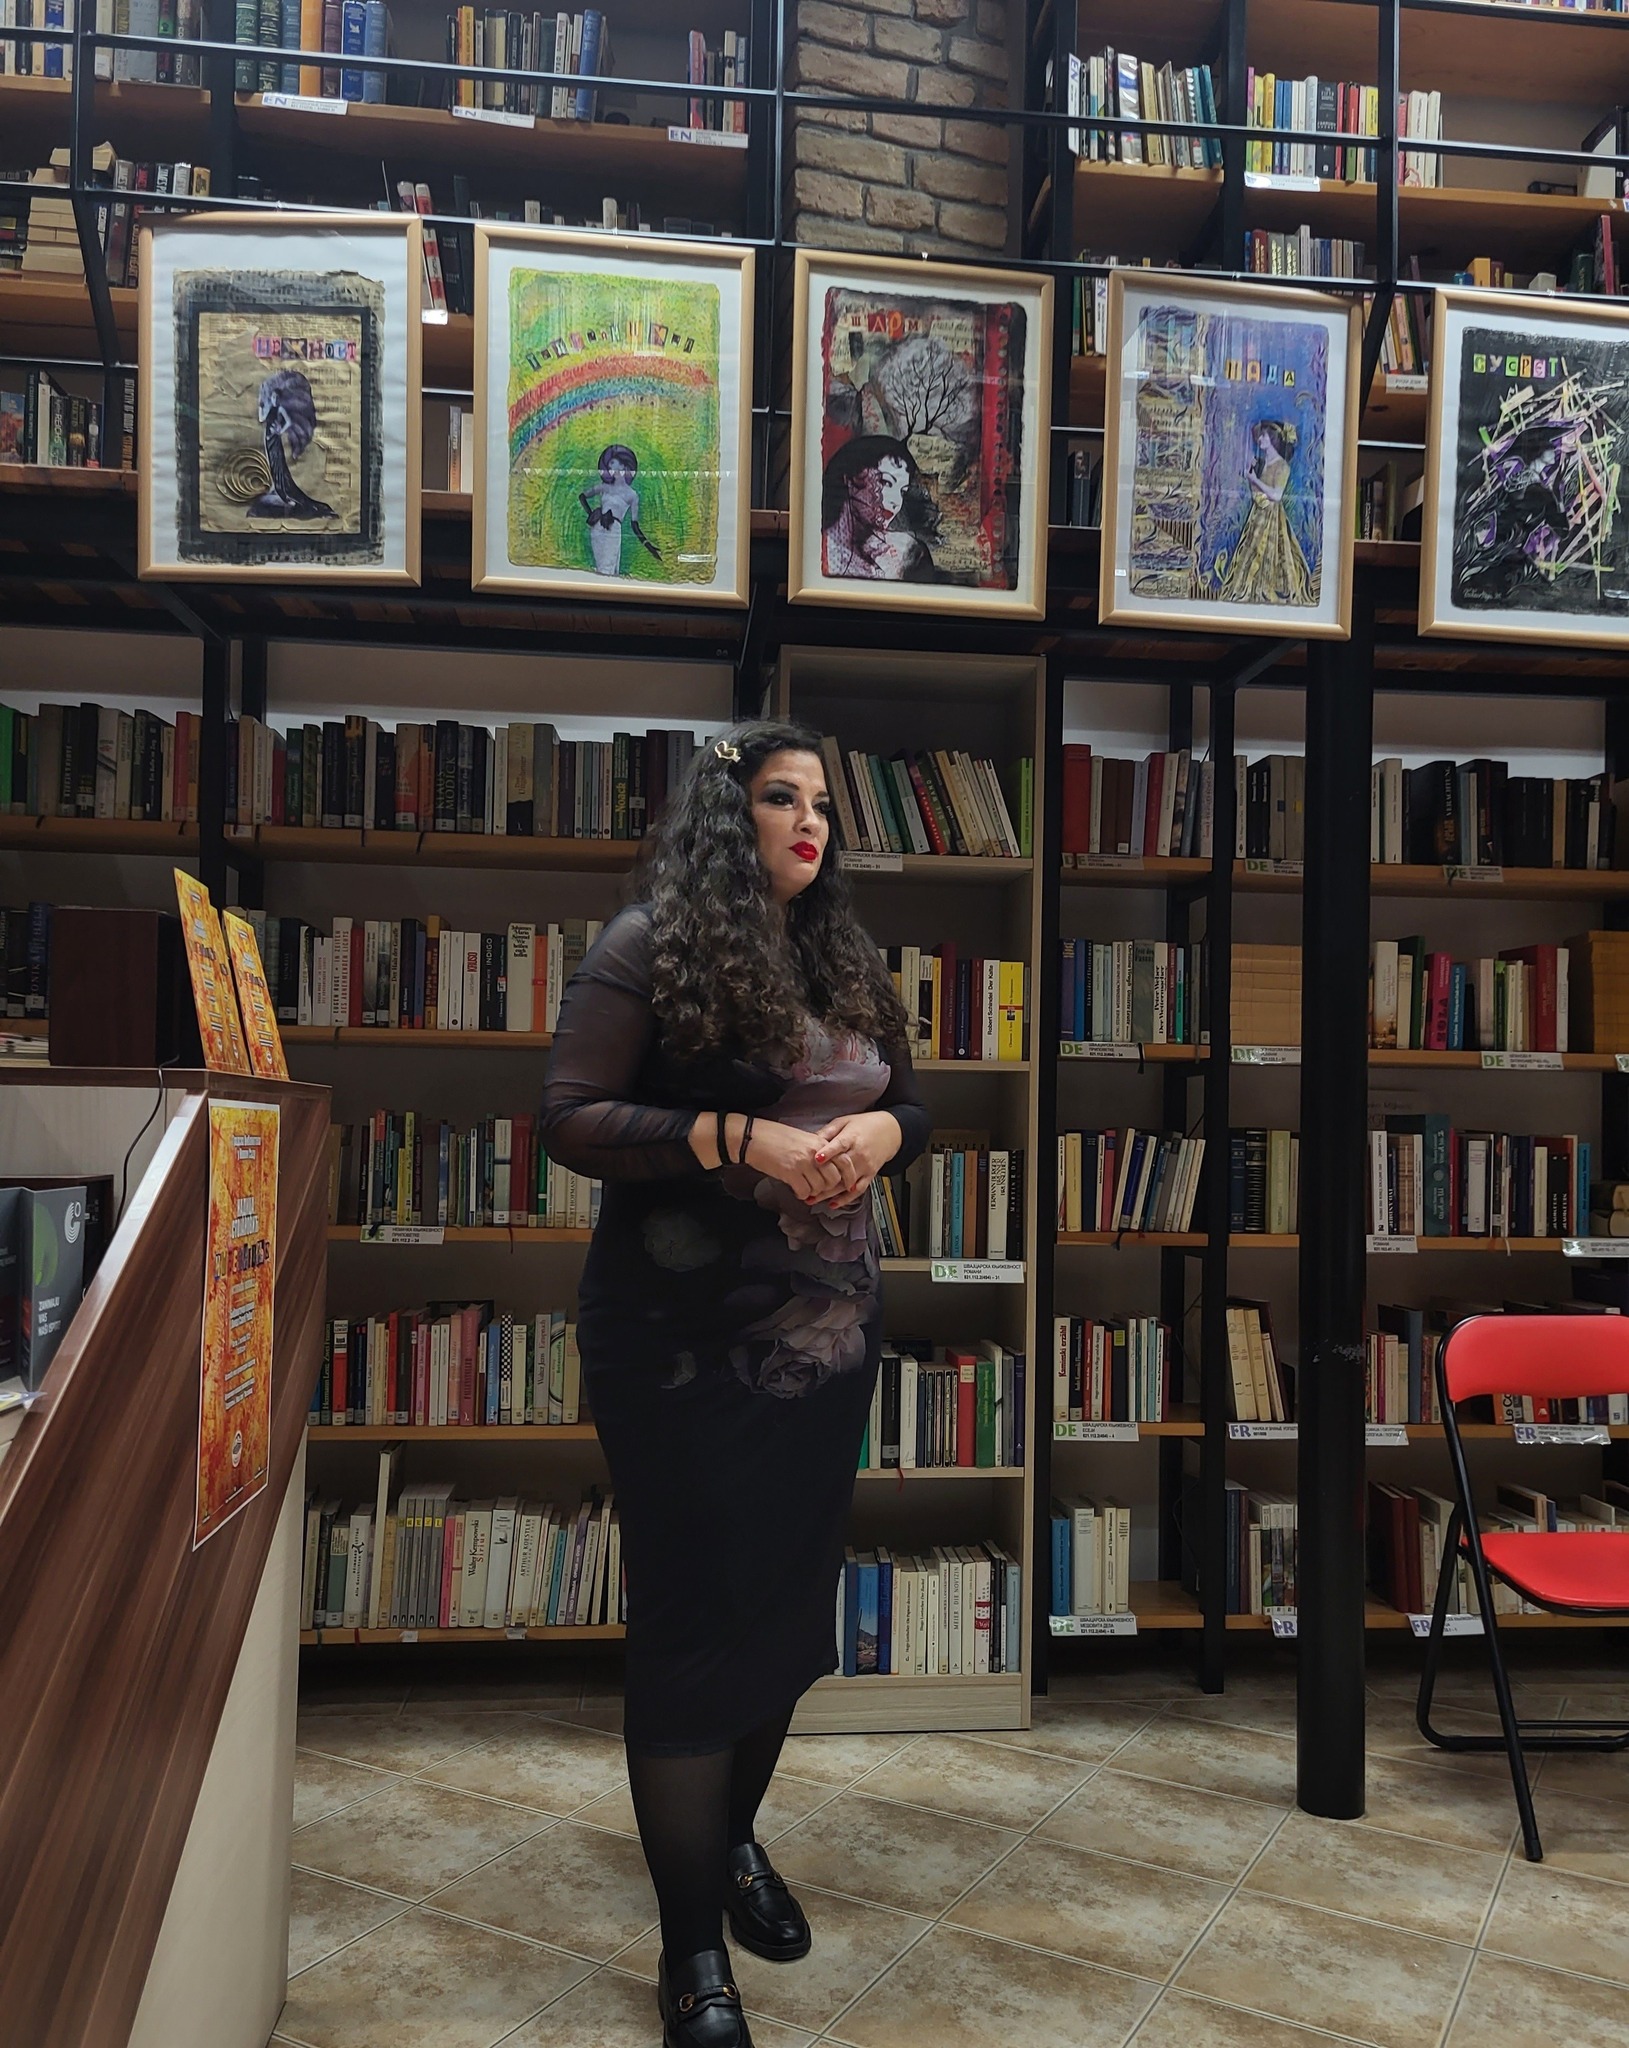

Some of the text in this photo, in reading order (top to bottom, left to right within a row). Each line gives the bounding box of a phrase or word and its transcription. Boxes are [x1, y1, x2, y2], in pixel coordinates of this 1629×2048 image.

[1071, 59, 1079, 80] EN
[851, 312, 918, 336] ШАРМ
[1475, 354, 1558, 378] СУСРЕТ
[437, 770, 445, 809] KLAUS
[446, 757, 456, 809] MODICK
[614, 782, 626, 812] Noack
[926, 780, 944, 820] DIE WAND
[1064, 855, 1087, 866] DE
[1247, 860, 1268, 872] DE
[34, 906, 42, 935] HELD
[467, 952, 478, 972] KRUSO
[1437, 998, 1448, 1042] ZOLA
[1061, 1043, 1083, 1054] DE
[1234, 1048, 1254, 1060] DE
[1483, 1055, 1505, 1066] DE
[934, 1265, 958, 1278] DE
[538, 1320, 547, 1349] Einspruch
[1058, 1325, 1067, 1377] Kaminski erzählt
[464, 1358, 472, 1400] FALLENSTELLER
[1506, 1409, 1514, 1422] Le
[1055, 1424, 1077, 1437] DE
[1231, 1425, 1251, 1437] FR
[523, 1518, 531, 1549] KOESTLER
[468, 1520, 480, 1576] Walter Kempowski
[1274, 1618, 1295, 1634] FR
[1412, 1620, 1430, 1632] FR
